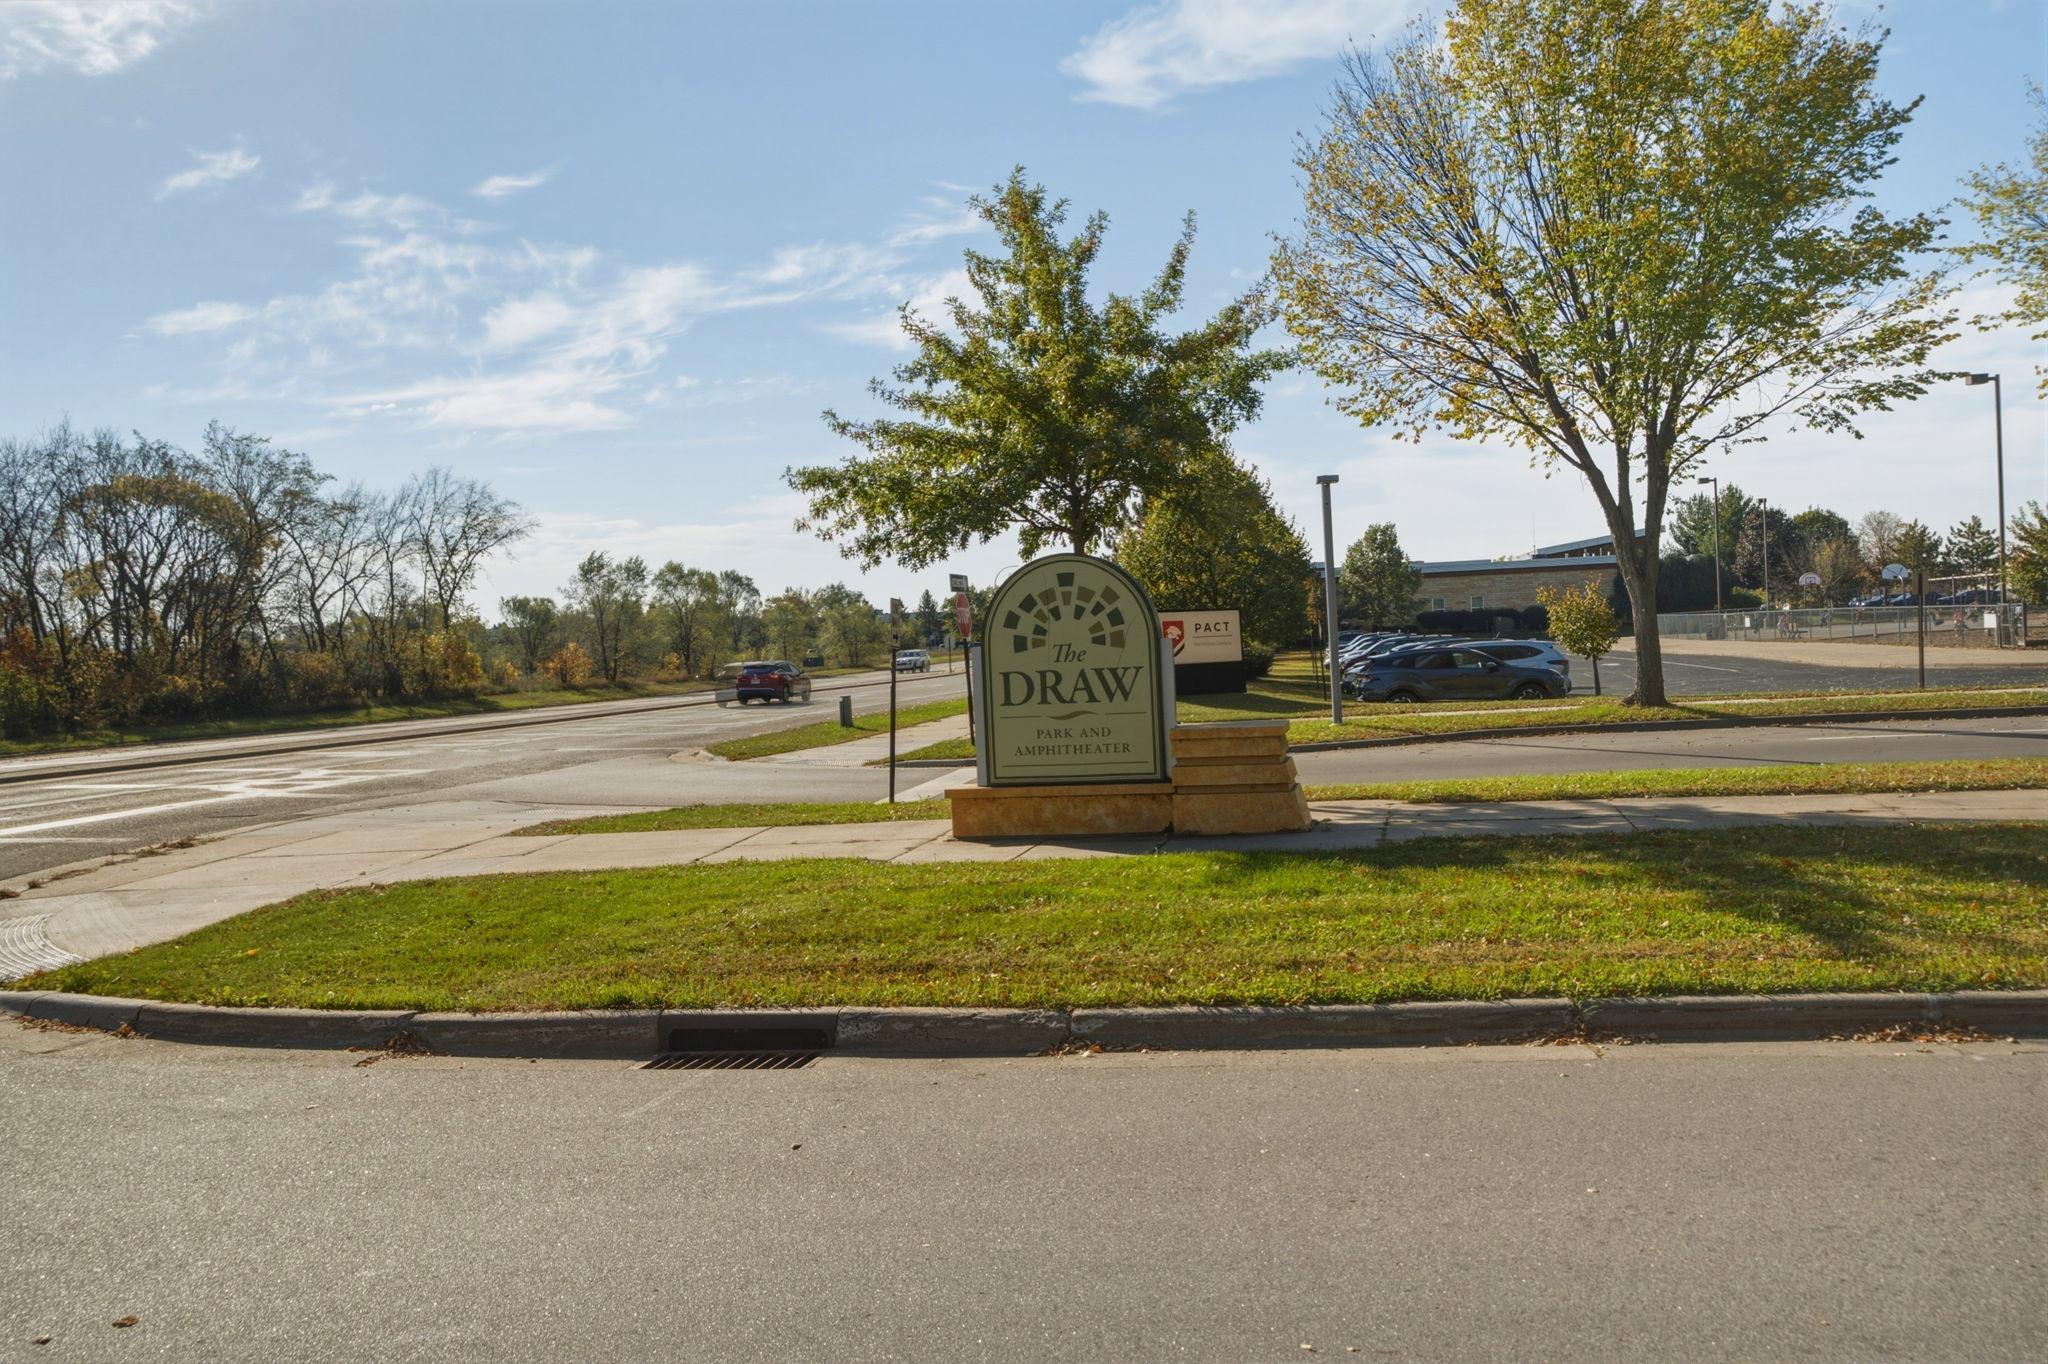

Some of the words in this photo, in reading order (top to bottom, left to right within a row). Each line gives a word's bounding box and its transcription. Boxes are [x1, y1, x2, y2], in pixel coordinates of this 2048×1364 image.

[1194, 621, 1230, 633] PACT
[1054, 643, 1086, 663] The
[1000, 666, 1145, 707] DRAW
[1036, 728, 1073, 740] PARK
[1080, 726, 1111, 738] AND
[1014, 743, 1132, 756] AMPHITHEATER
